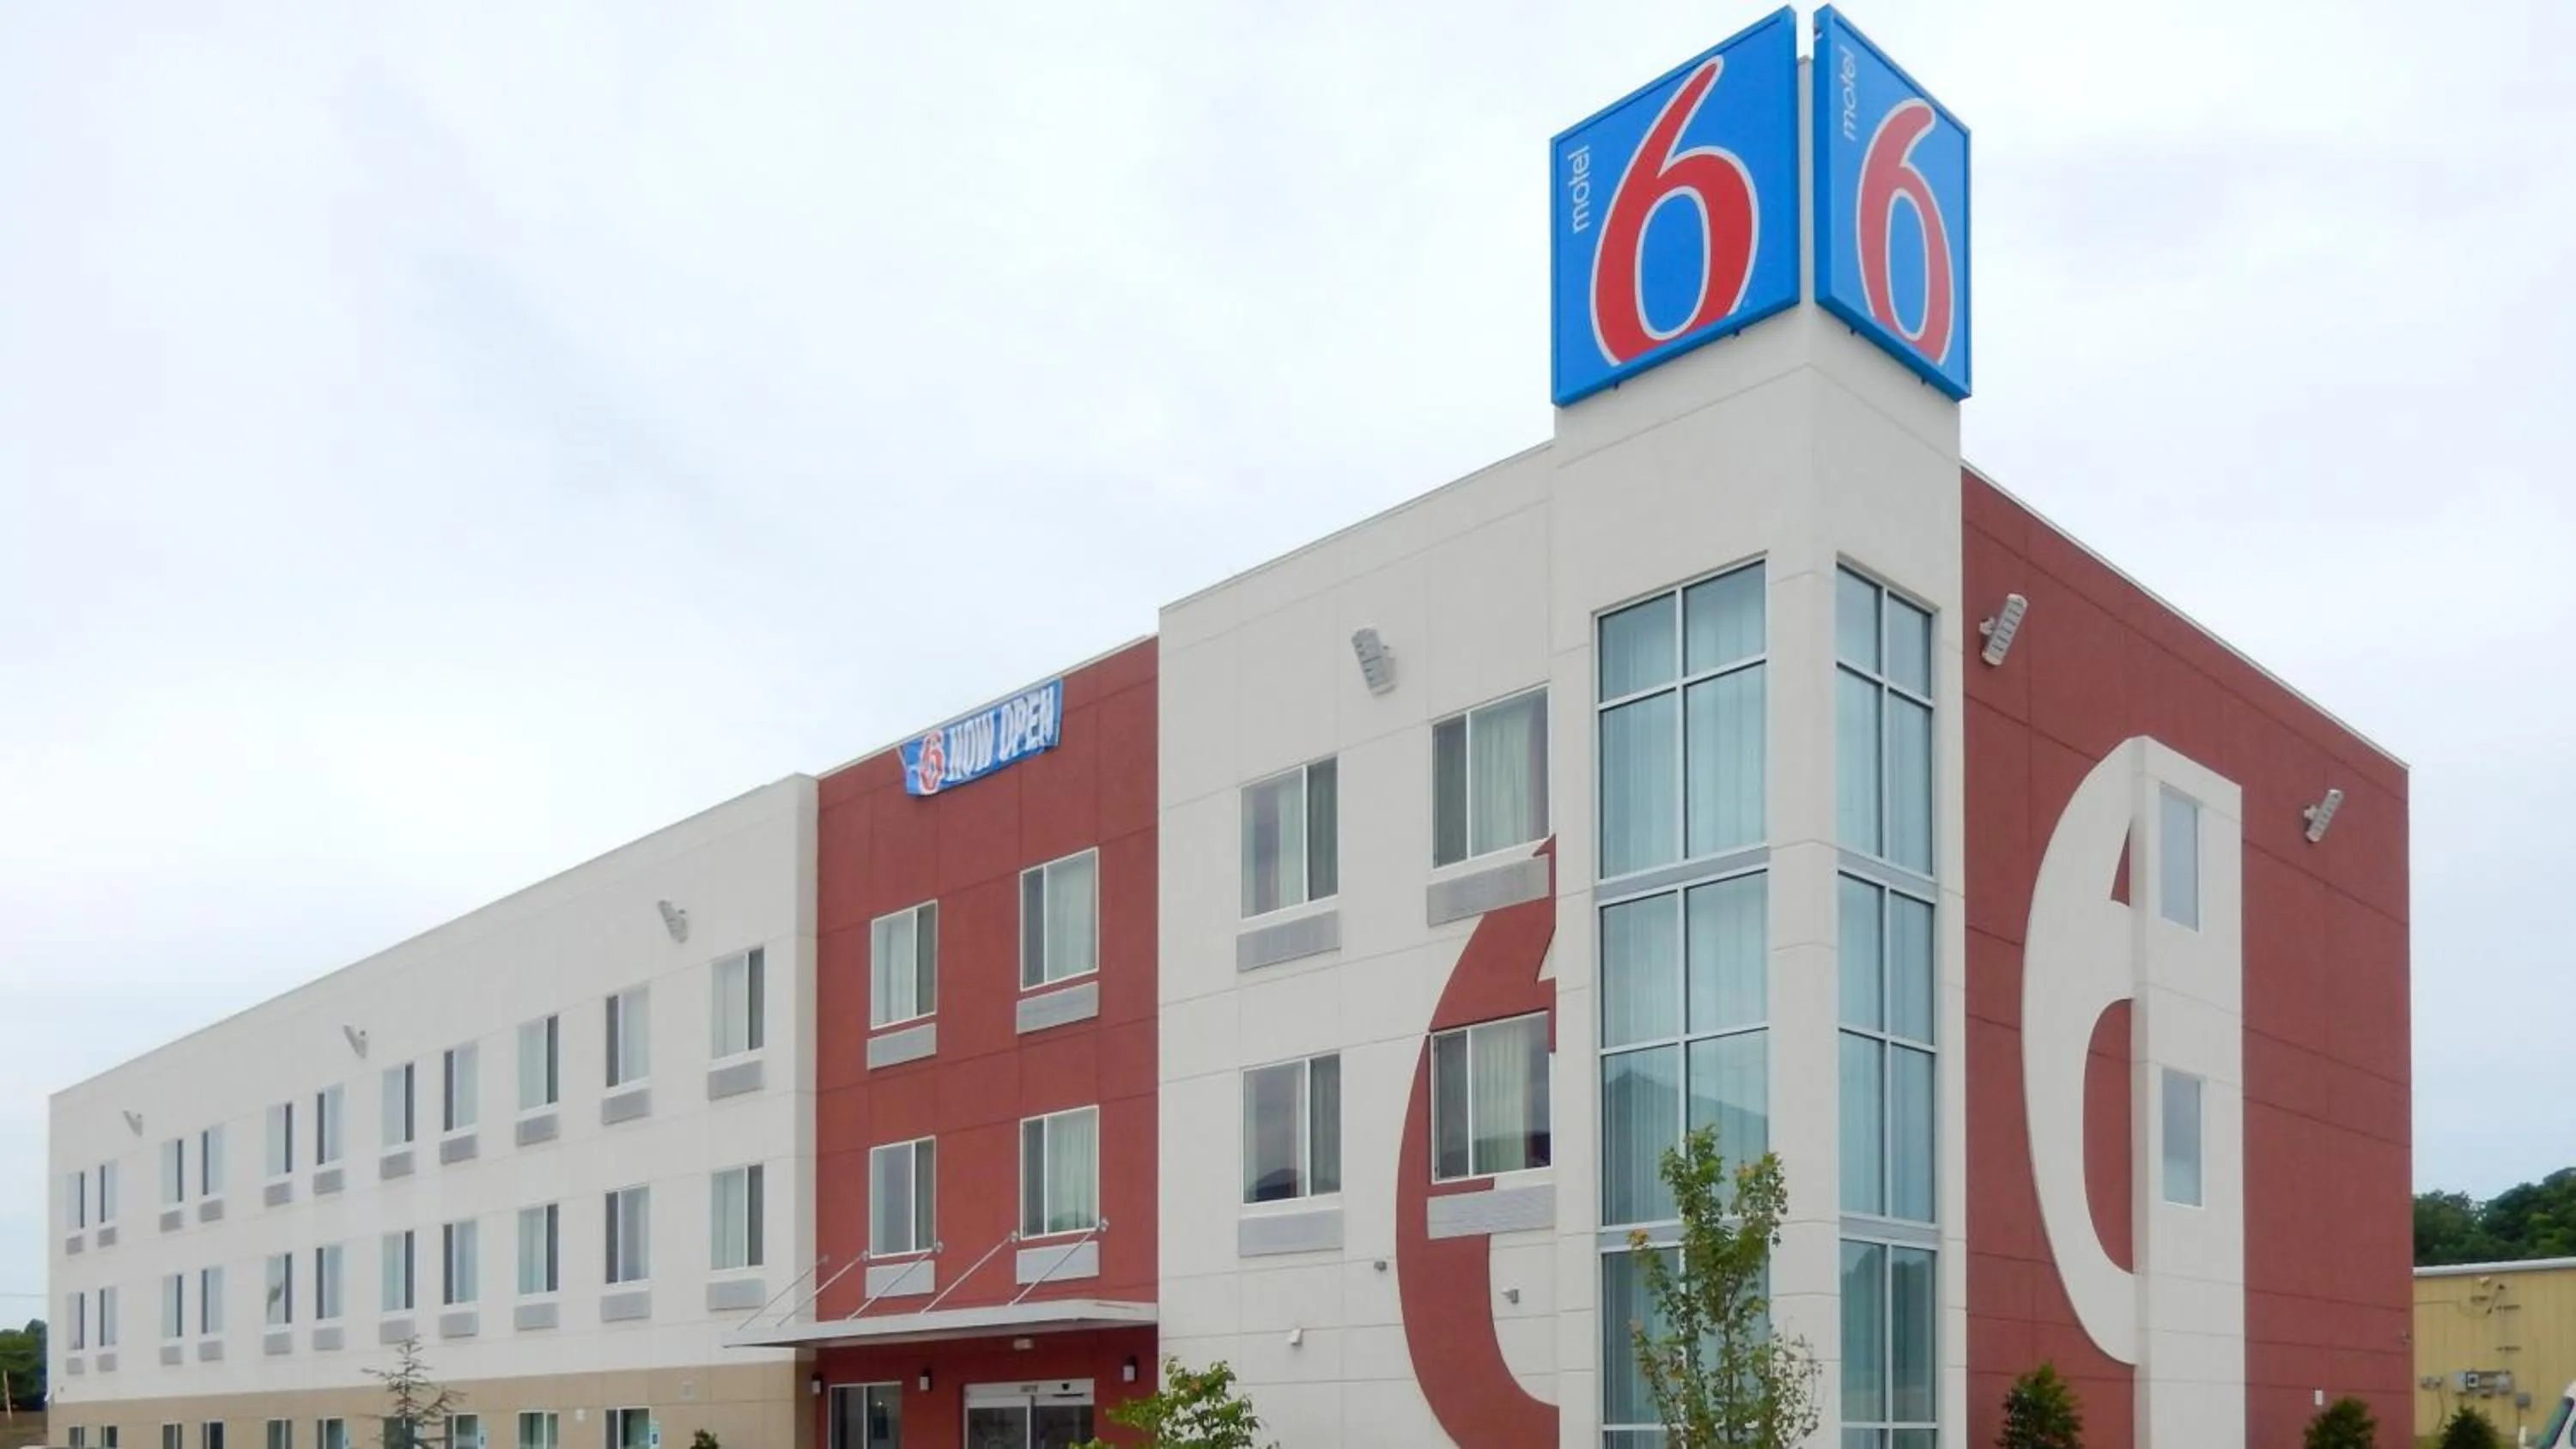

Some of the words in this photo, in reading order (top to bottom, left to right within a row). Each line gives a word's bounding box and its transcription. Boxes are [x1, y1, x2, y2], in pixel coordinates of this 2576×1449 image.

[1838, 45, 1856, 142] motel
[1567, 145, 1590, 233] motel
[1589, 55, 1759, 367] 6
[1856, 98, 1954, 366] 6
[920, 730, 945, 795] 6
[946, 710, 995, 782] NOW
[998, 686, 1054, 762] OPEN
